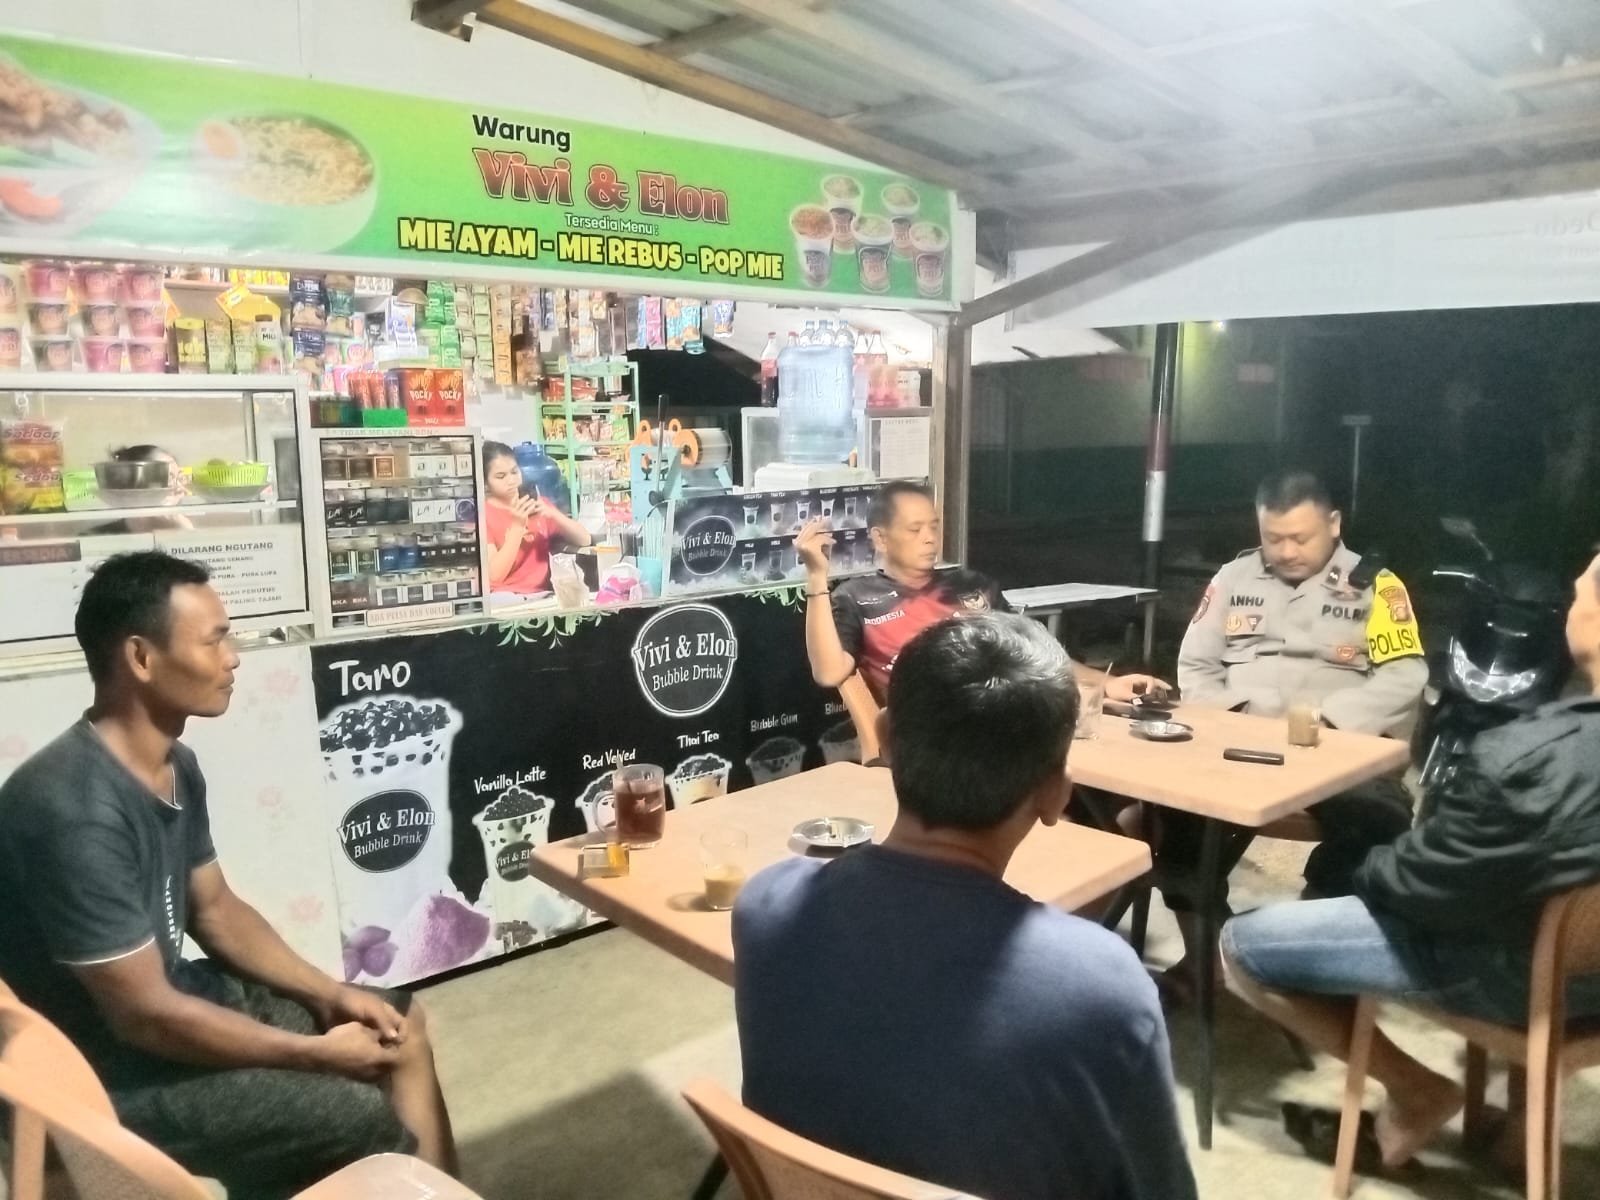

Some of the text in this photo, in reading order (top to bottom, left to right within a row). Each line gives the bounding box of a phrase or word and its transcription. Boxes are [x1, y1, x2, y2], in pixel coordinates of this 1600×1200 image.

[472, 114, 571, 152] Warung
[472, 147, 730, 225] Vivi & Elon
[565, 213, 618, 231] Tersedia
[398, 217, 454, 252] MIE
[456, 222, 537, 258] AYAM
[556, 232, 604, 264] MIE
[606, 238, 684, 271] REBUS
[699, 247, 745, 278] POP
[746, 250, 784, 280] MIE
[171, 542, 274, 555] DILARANG NGUTANG
[682, 531, 737, 550] Vivi & Elon
[634, 632, 736, 672] Vivi & Elon
[1368, 627, 1418, 660] POLISI
[328, 659, 411, 696] Taro
[652, 664, 724, 691] Bubble Drink
[824, 702, 848, 715] Blueb
[750, 714, 779, 732] Bubble
[676, 729, 720, 749] Thai Tea
[582, 754, 604, 770] Red
[474, 765, 547, 795] Vanilla Latte
[338, 807, 435, 844] Vivi & Elon
[354, 831, 423, 859] Bubble Drink
